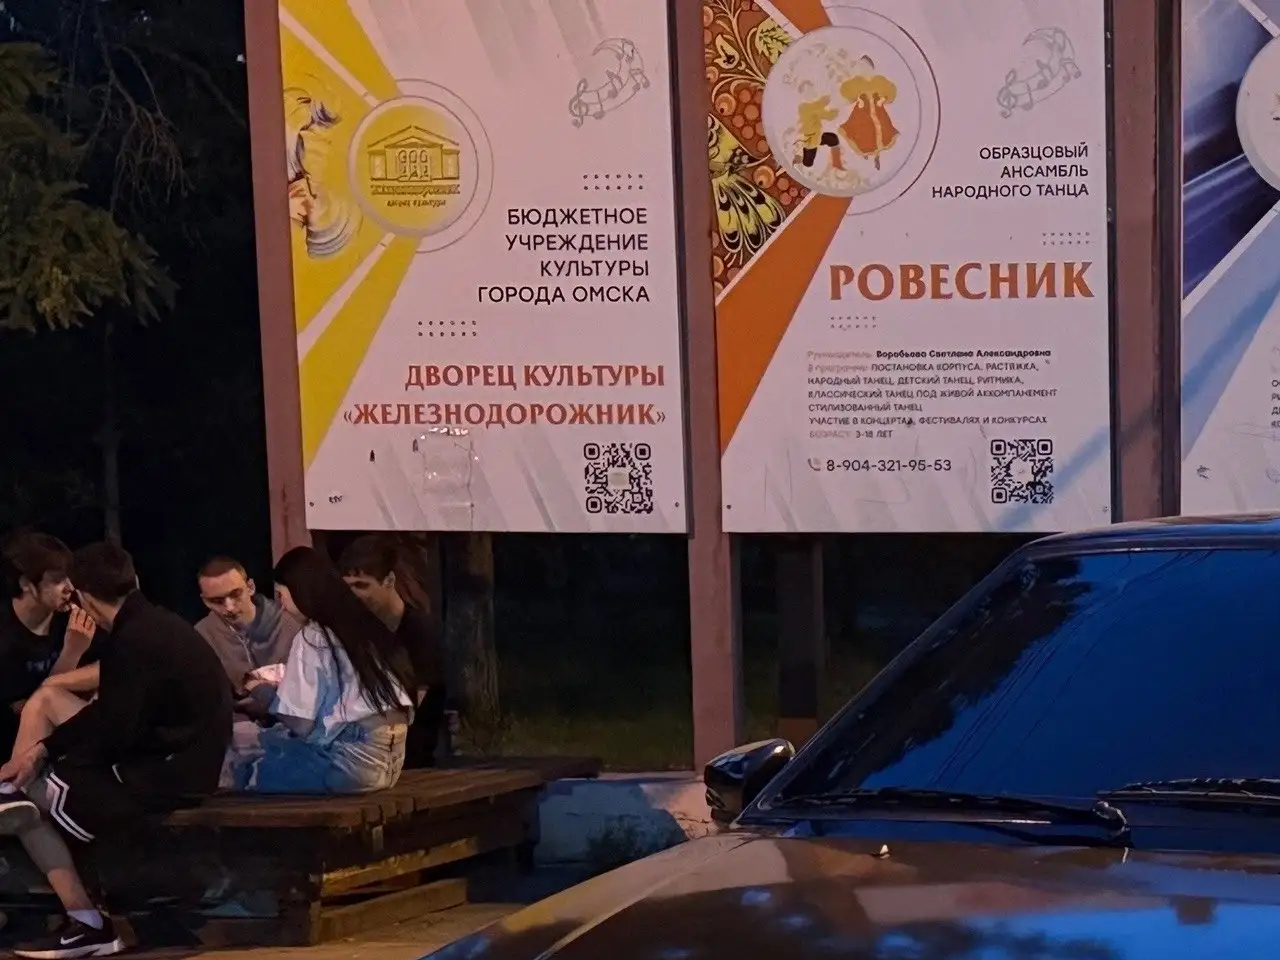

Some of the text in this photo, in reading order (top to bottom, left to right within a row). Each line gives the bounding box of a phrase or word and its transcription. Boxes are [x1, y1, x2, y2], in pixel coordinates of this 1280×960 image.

[979, 142, 1088, 160] ОБРАЗЦОВЫЙ
[1000, 165, 1089, 179] АНСАМБЛЬ
[932, 184, 1089, 200] НАРОДНОГО ТАНЦА
[508, 207, 648, 227] БЮДЖЕТНОЕ
[505, 234, 649, 253] УЧРЕЖДЕНИЕ
[540, 260, 650, 277] КУЛЬТУРЫ
[829, 262, 1095, 301] РОВЕСНИК
[478, 285, 650, 305] ГОРОДА ОМСКА
[405, 364, 665, 391] ДВОРЕЦ КУЛЬТУРЫ
[916, 389, 938, 399] ПОД
[343, 403, 666, 428] «ЖЕЛЕЗНОДОРОЖНИК»
[826, 459, 952, 472] 8-904-321-95-53
